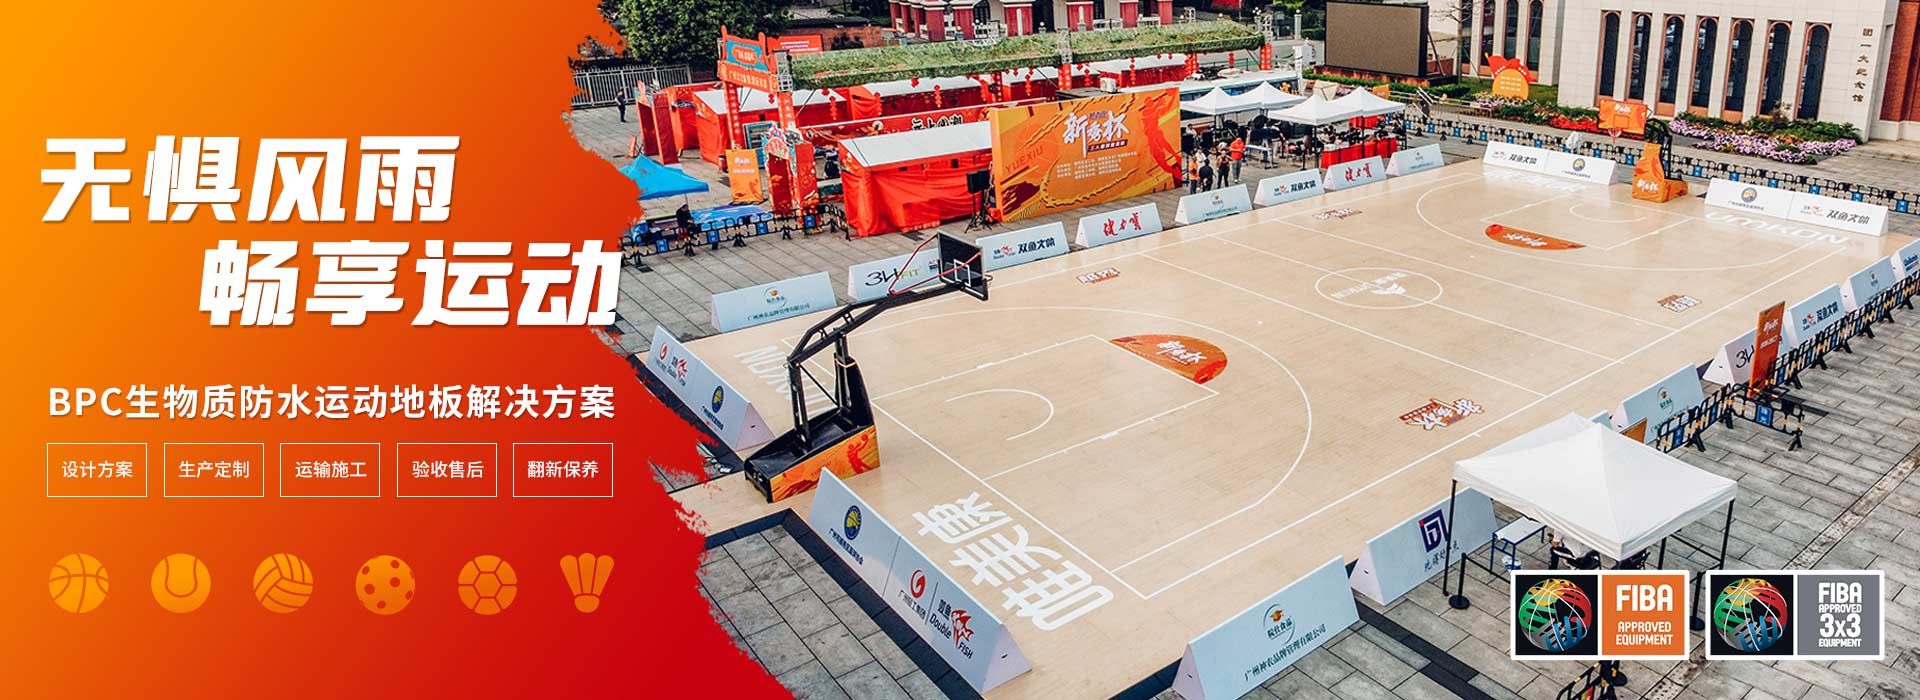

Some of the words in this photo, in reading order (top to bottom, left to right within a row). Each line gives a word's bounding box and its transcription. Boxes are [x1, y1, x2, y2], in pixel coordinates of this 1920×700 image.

[1005, 146, 1043, 174] YUEXIU
[912, 491, 1114, 631] 唯美康
[929, 613, 952, 639] Double
[958, 642, 974, 660] FISH
